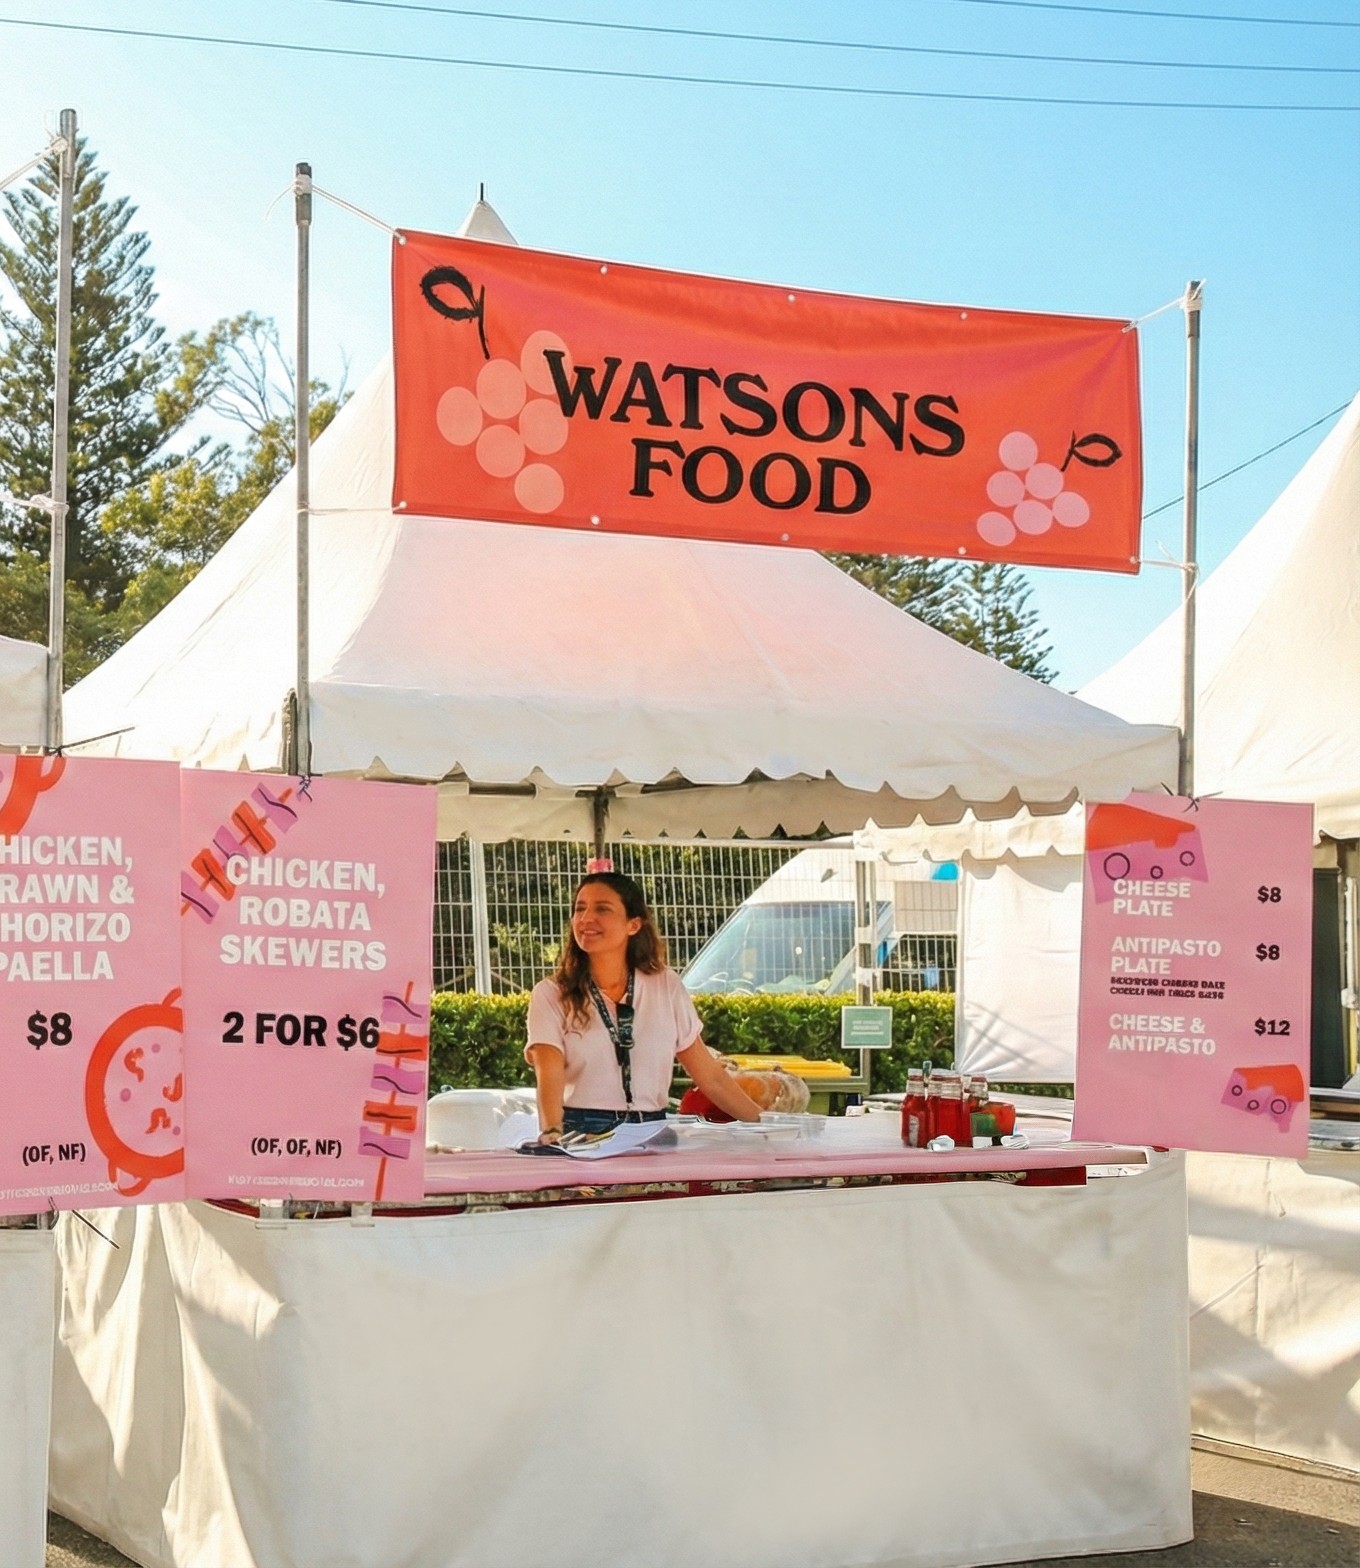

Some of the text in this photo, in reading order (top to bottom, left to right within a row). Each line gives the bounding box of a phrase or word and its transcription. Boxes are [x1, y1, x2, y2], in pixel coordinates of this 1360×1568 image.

[543, 349, 965, 457] WATSONS
[629, 438, 871, 514] FOOD
[226, 854, 385, 899] CHICKEN,
[109, 874, 135, 904] &
[1113, 879, 1191, 898] CHEESE
[1257, 885, 1282, 904] $8
[240, 896, 371, 931] ROBATA
[1113, 899, 1173, 917] PLATE
[219, 934, 386, 971] SKEWERS
[1111, 936, 1221, 957] ANTIPASTO
[1255, 943, 1280, 961] $8
[1111, 956, 1172, 974] PLATE
[26, 1010, 73, 1050] $8
[221, 1011, 380, 1051] 2 FOR $6
[1109, 1013, 1206, 1034] CHEESE &
[1254, 1017, 1291, 1036] $12
[1108, 1034, 1216, 1056] ANTIPASTO
[22, 1142, 86, 1167] (OF, NF)
[251, 1138, 342, 1159] (OF, OF, NF)
